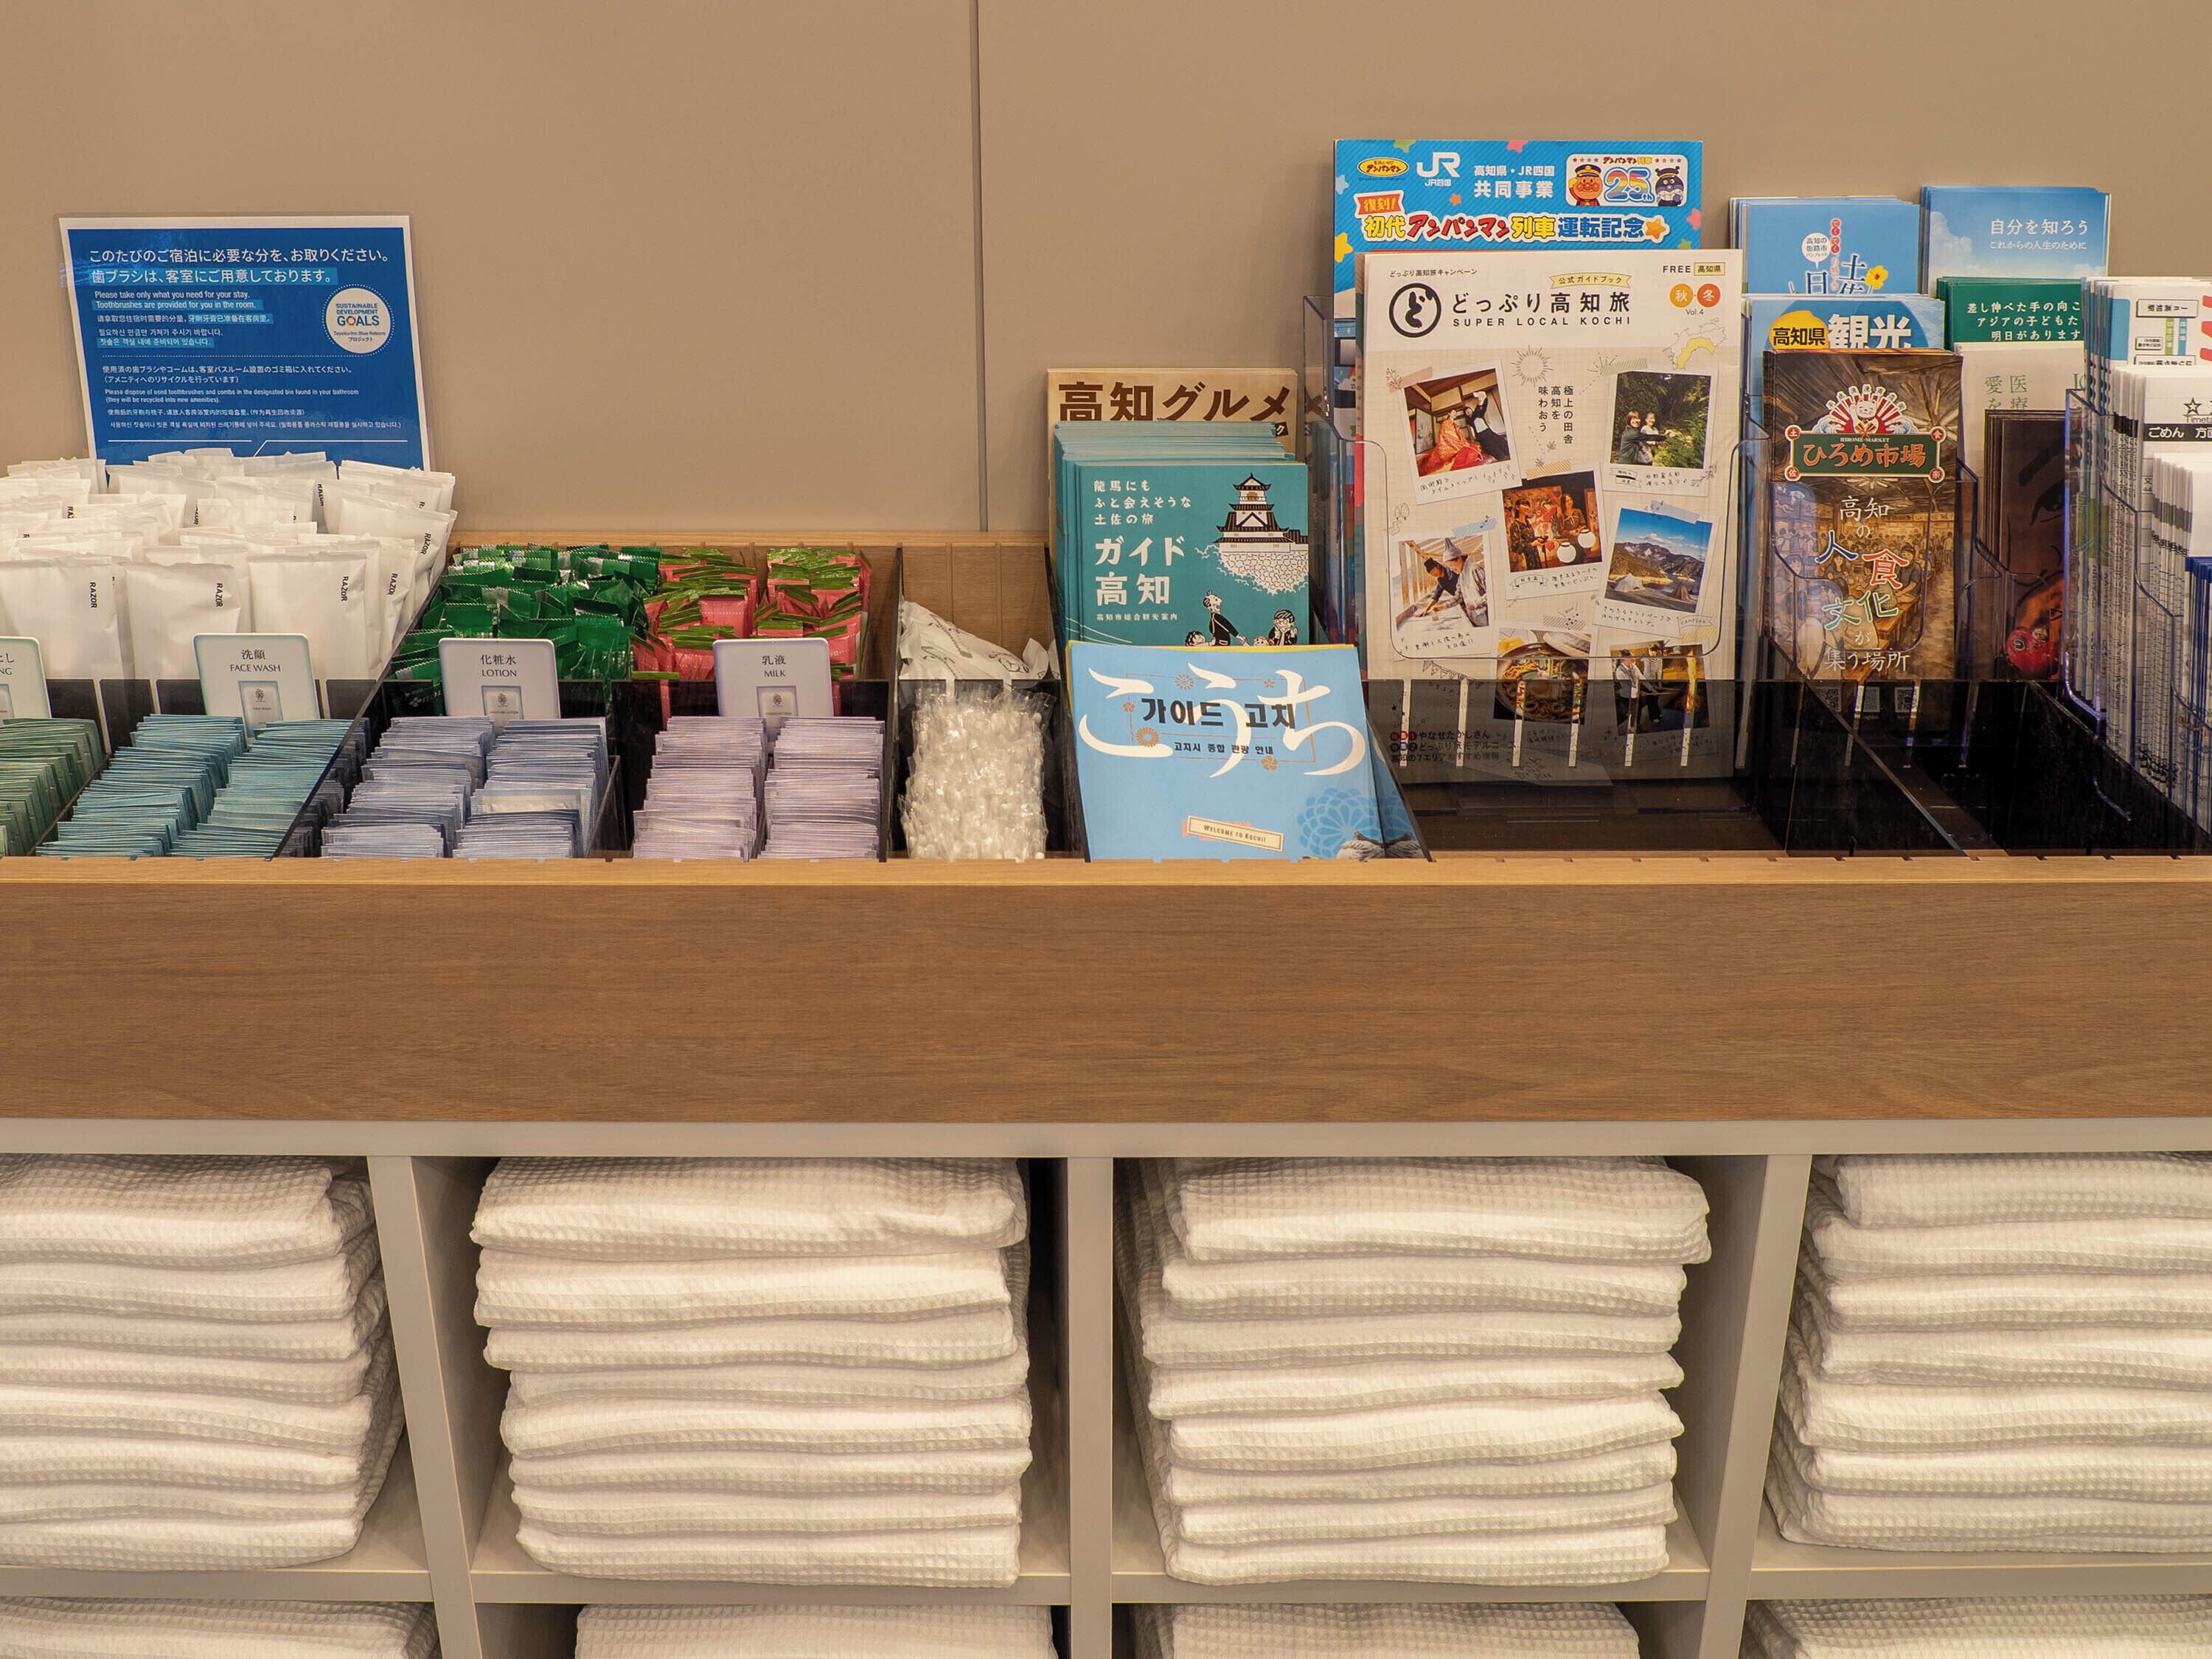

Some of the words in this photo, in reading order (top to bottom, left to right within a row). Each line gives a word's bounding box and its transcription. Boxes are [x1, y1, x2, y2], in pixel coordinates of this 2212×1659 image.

[1416, 152, 1461, 178] JR
[1475, 165, 1555, 176] 高知県・JR四国
[1474, 181, 1554, 198] 共同事業
[1365, 215, 1645, 239] 初代アンパンマン列車運転記念
[1990, 218, 2090, 235] 自分を知ろう
[1990, 240, 2087, 251] これからの人生のために
[89, 248, 389, 263] このたびのご宿泊に必要な分を、お取りください。
[92, 269, 333, 285] 歯ブラシは、客室にご用意しております。
[1389, 268, 1478, 278] どっぷり高知旅キャンペーン
[1558, 275, 1622, 285] 公式ガイドブック
[1453, 292, 1630, 313] どっぷり高知旅
[1674, 291, 1688, 302] 秋
[1703, 290, 1714, 302] 冬
[97, 301, 142, 309] Toothbrushes
[145, 301, 155, 309] are
[158, 301, 187, 309] provided
[189, 301, 198, 309] for
[201, 301, 213, 309] you
[215, 301, 221, 309] in
[223, 301, 234, 309] the
[236, 301, 257, 309] room.
[1967, 301, 2081, 313] 差し伸べた手の向こ
[337, 315, 380, 326] GOALS
[1453, 319, 1505, 327] SUPER
[1517, 318, 1569, 326] LOCAL
[1581, 317, 1630, 325] KOCHI
[1978, 315, 2079, 327] アジアの子どもた
[172, 329, 192, 337] 주시기
[1773, 327, 1826, 347] 高知県
[1827, 314, 1912, 348] 観光
[1992, 330, 2081, 341] 明日があります
[181, 338, 211, 346] 있습니다.
[1059, 381, 1290, 421] 高知グルメ
[1538, 385, 1548, 432] 味わおう
[1551, 385, 1561, 420] 高知を
[1563, 385, 1574, 445] 極上の田舎
[2149, 427, 2185, 438] ごめん
[1803, 442, 1927, 468] ひろめ市場
[1094, 479, 1150, 493] 龍馬にも
[1094, 496, 1192, 509] ふと会えそうな
[1840, 495, 1891, 522] 高知
[1094, 513, 1154, 526] 土佐の旅
[1856, 524, 1871, 540] の
[420, 532, 431, 554] RAZOR
[1095, 535, 1185, 567] ガイド
[1816, 529, 1858, 564] 人
[1863, 548, 1910, 589] 食
[341, 576, 349, 602] RAZOR
[387, 573, 398, 596] RAZOR
[1095, 573, 1170, 606] 高知
[89, 582, 97, 608] RAZOR
[215, 582, 223, 608] RAZOR
[1822, 590, 1899, 632] 文化
[1854, 630, 1872, 645] が
[242, 649, 265, 660] 洗顔
[480, 655, 517, 665] 化粧水
[762, 655, 786, 665] 乳液
[1823, 649, 1910, 673] 集う場所
[481, 669, 517, 677] LOTION
[1141, 697, 1224, 728] 가이드
[1245, 703, 1296, 729] 고치
[1231, 744, 1250, 754] 관광
[1255, 745, 1274, 755] 안내
